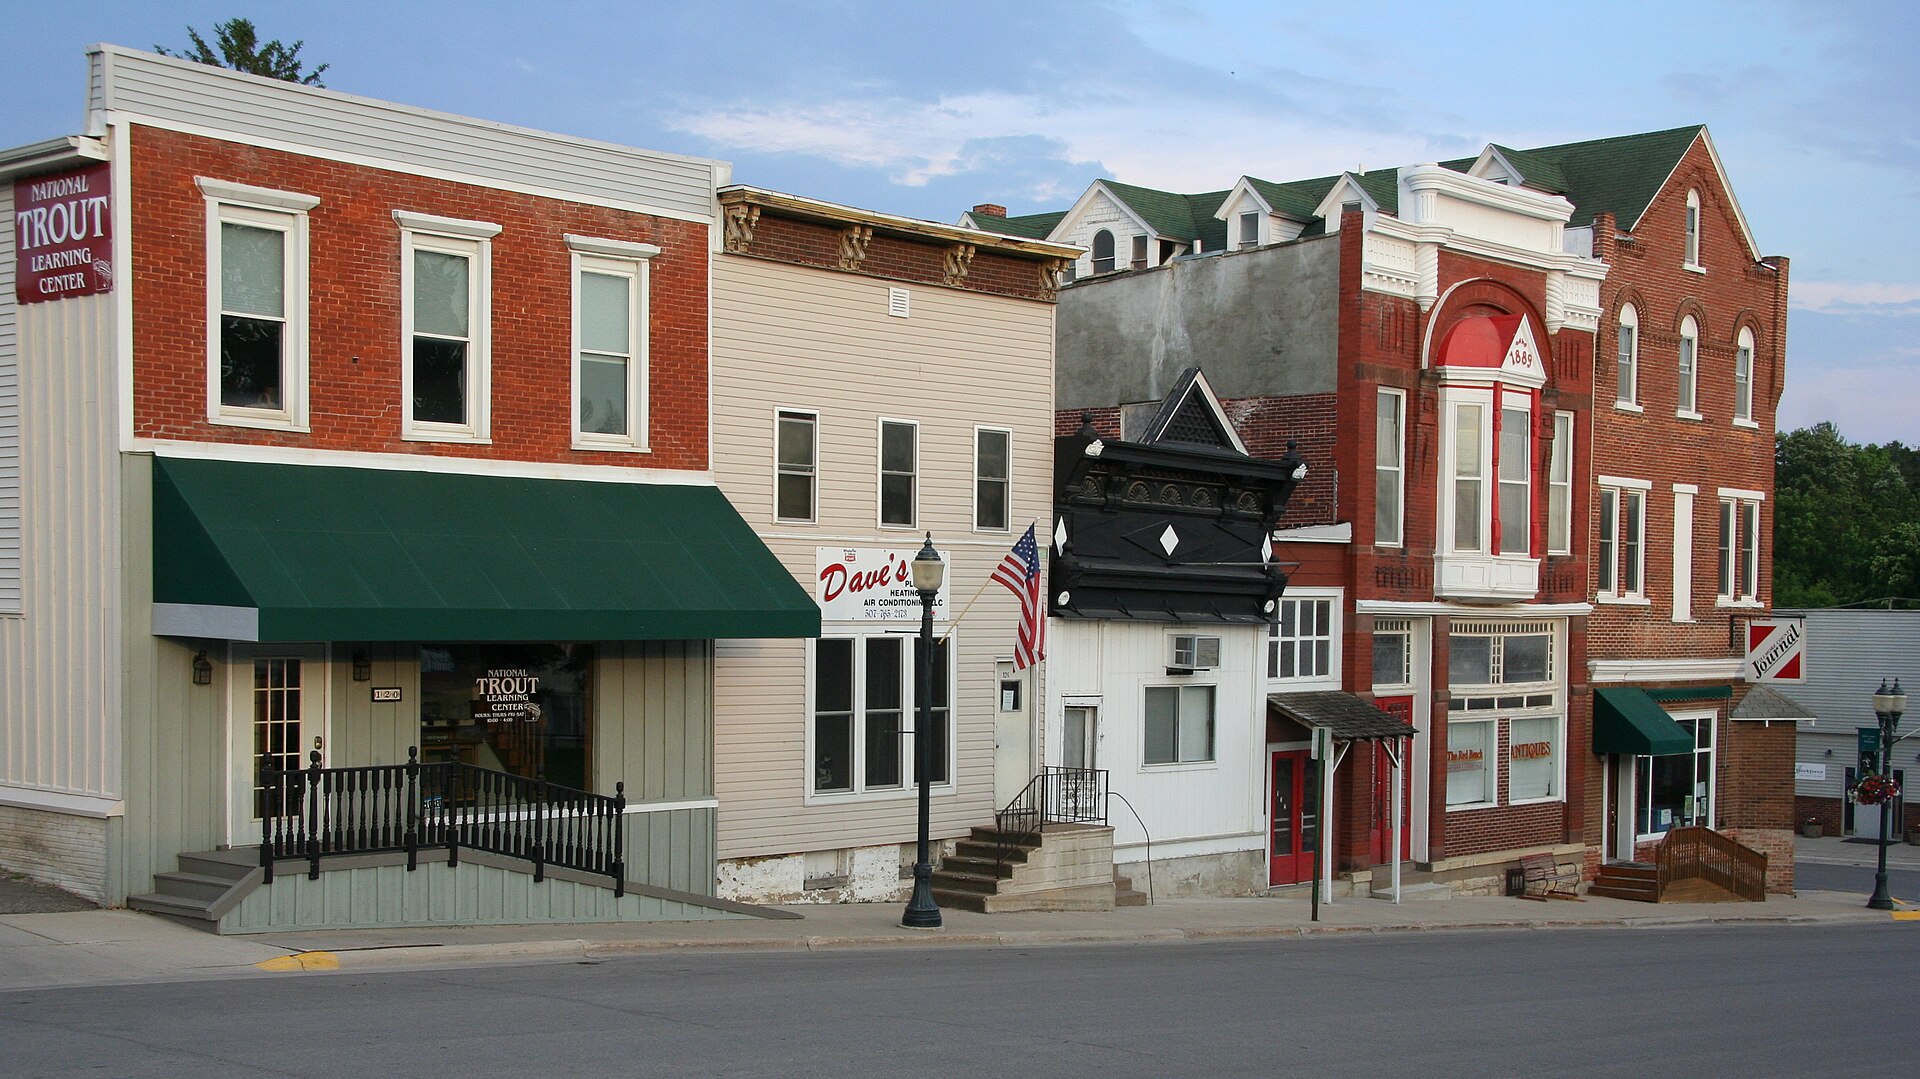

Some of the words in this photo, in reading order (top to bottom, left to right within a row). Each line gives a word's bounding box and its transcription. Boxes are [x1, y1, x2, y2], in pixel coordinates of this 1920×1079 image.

[32, 175, 89, 202] NATIONAL
[18, 196, 108, 250] TROUT
[32, 248, 91, 272] LEARNING
[40, 272, 85, 294] CENTER
[1510, 350, 1532, 368] 1889
[820, 553, 909, 602] Dave's
[878, 599, 923, 607] CONDITIONIN
[1752, 624, 1800, 679] Journal
[488, 669, 528, 677] NATIONAL
[476, 677, 540, 694] TROUT
[376, 691, 398, 699] 120
[487, 694, 528, 702] LEARNING
[491, 703, 524, 711] CENTER
[1511, 741, 1551, 759] ANTIQUES
